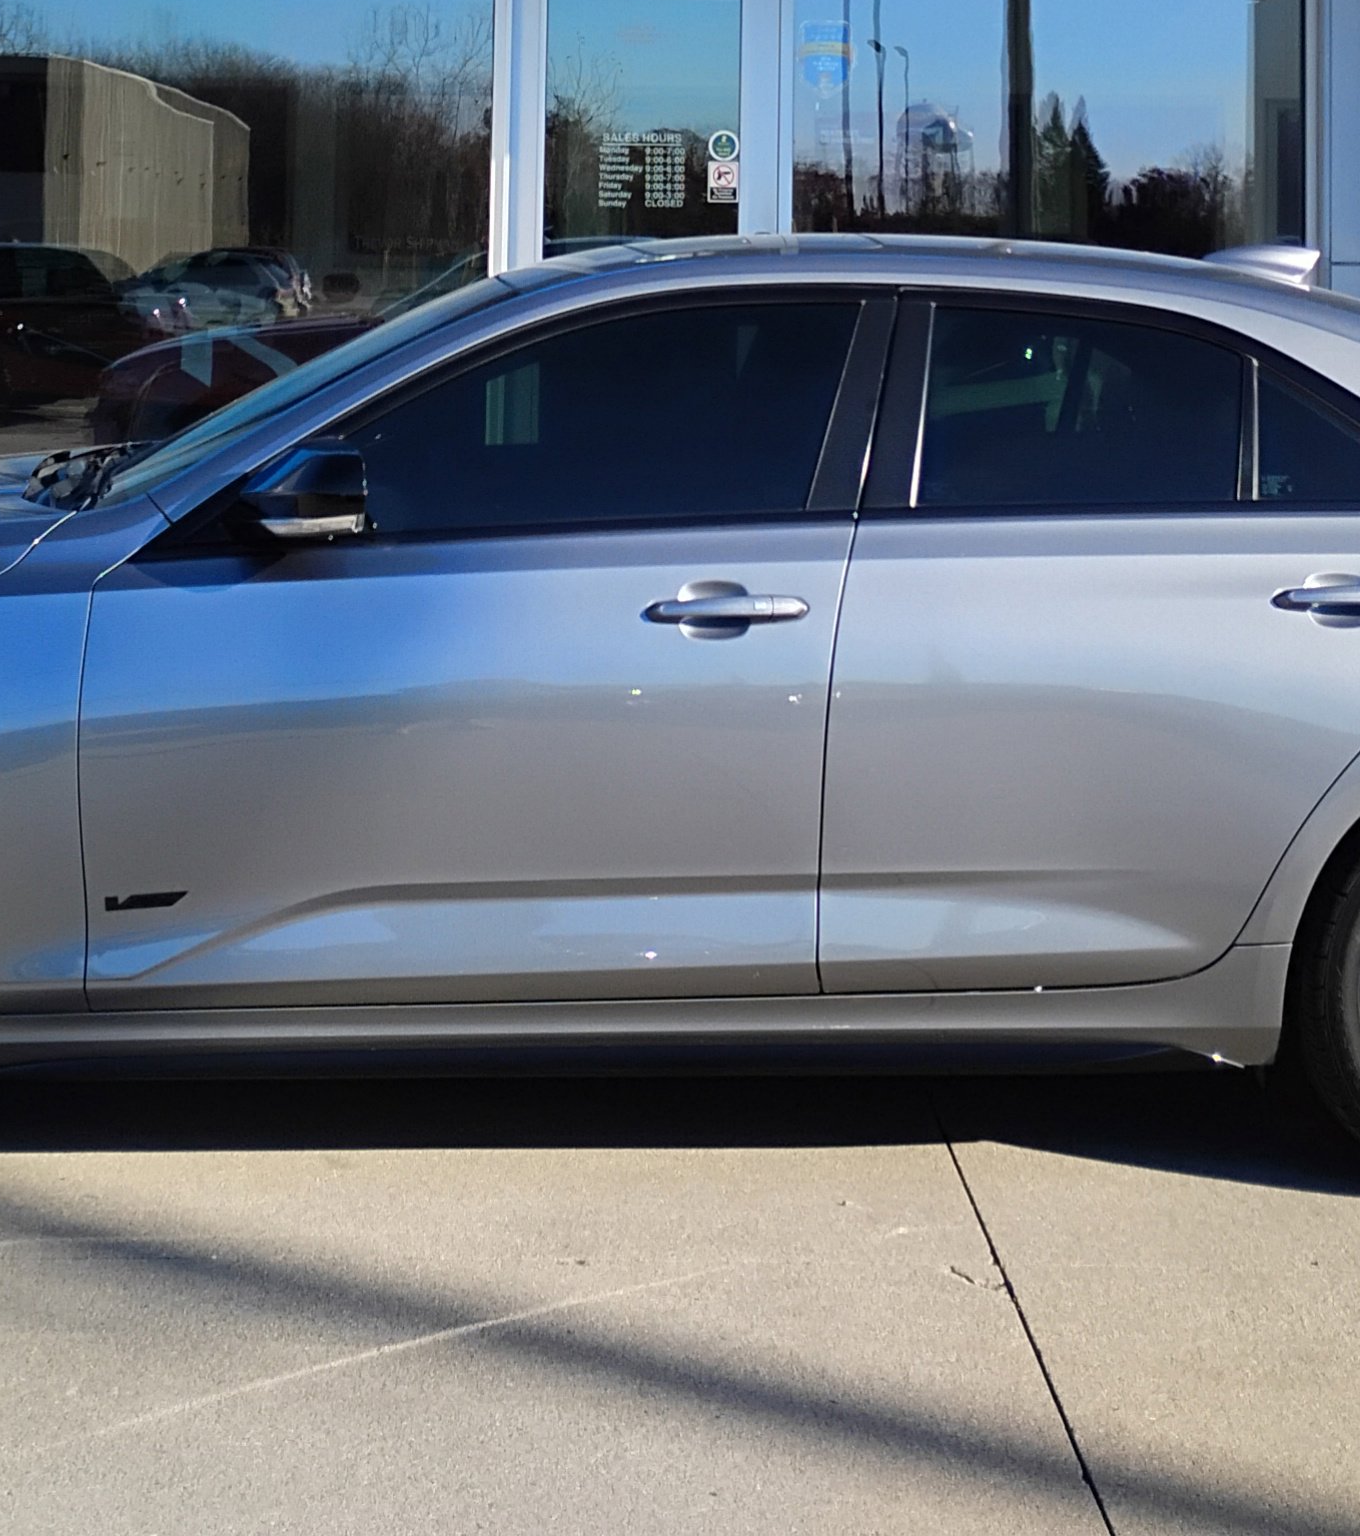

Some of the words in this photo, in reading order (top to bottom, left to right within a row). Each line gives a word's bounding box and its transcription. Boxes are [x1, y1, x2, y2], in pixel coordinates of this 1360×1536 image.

[602, 132, 640, 142] SALES
[642, 133, 682, 143] HOURS
[599, 146, 630, 155] Monday
[598, 155, 630, 164] Tuesday
[598, 164, 643, 173] Wednesday
[598, 172, 634, 182] Thursday
[598, 181, 622, 190] Friday
[598, 190, 632, 199] Saturday
[598, 199, 627, 208] Sunday
[644, 199, 684, 208] CLOSED
